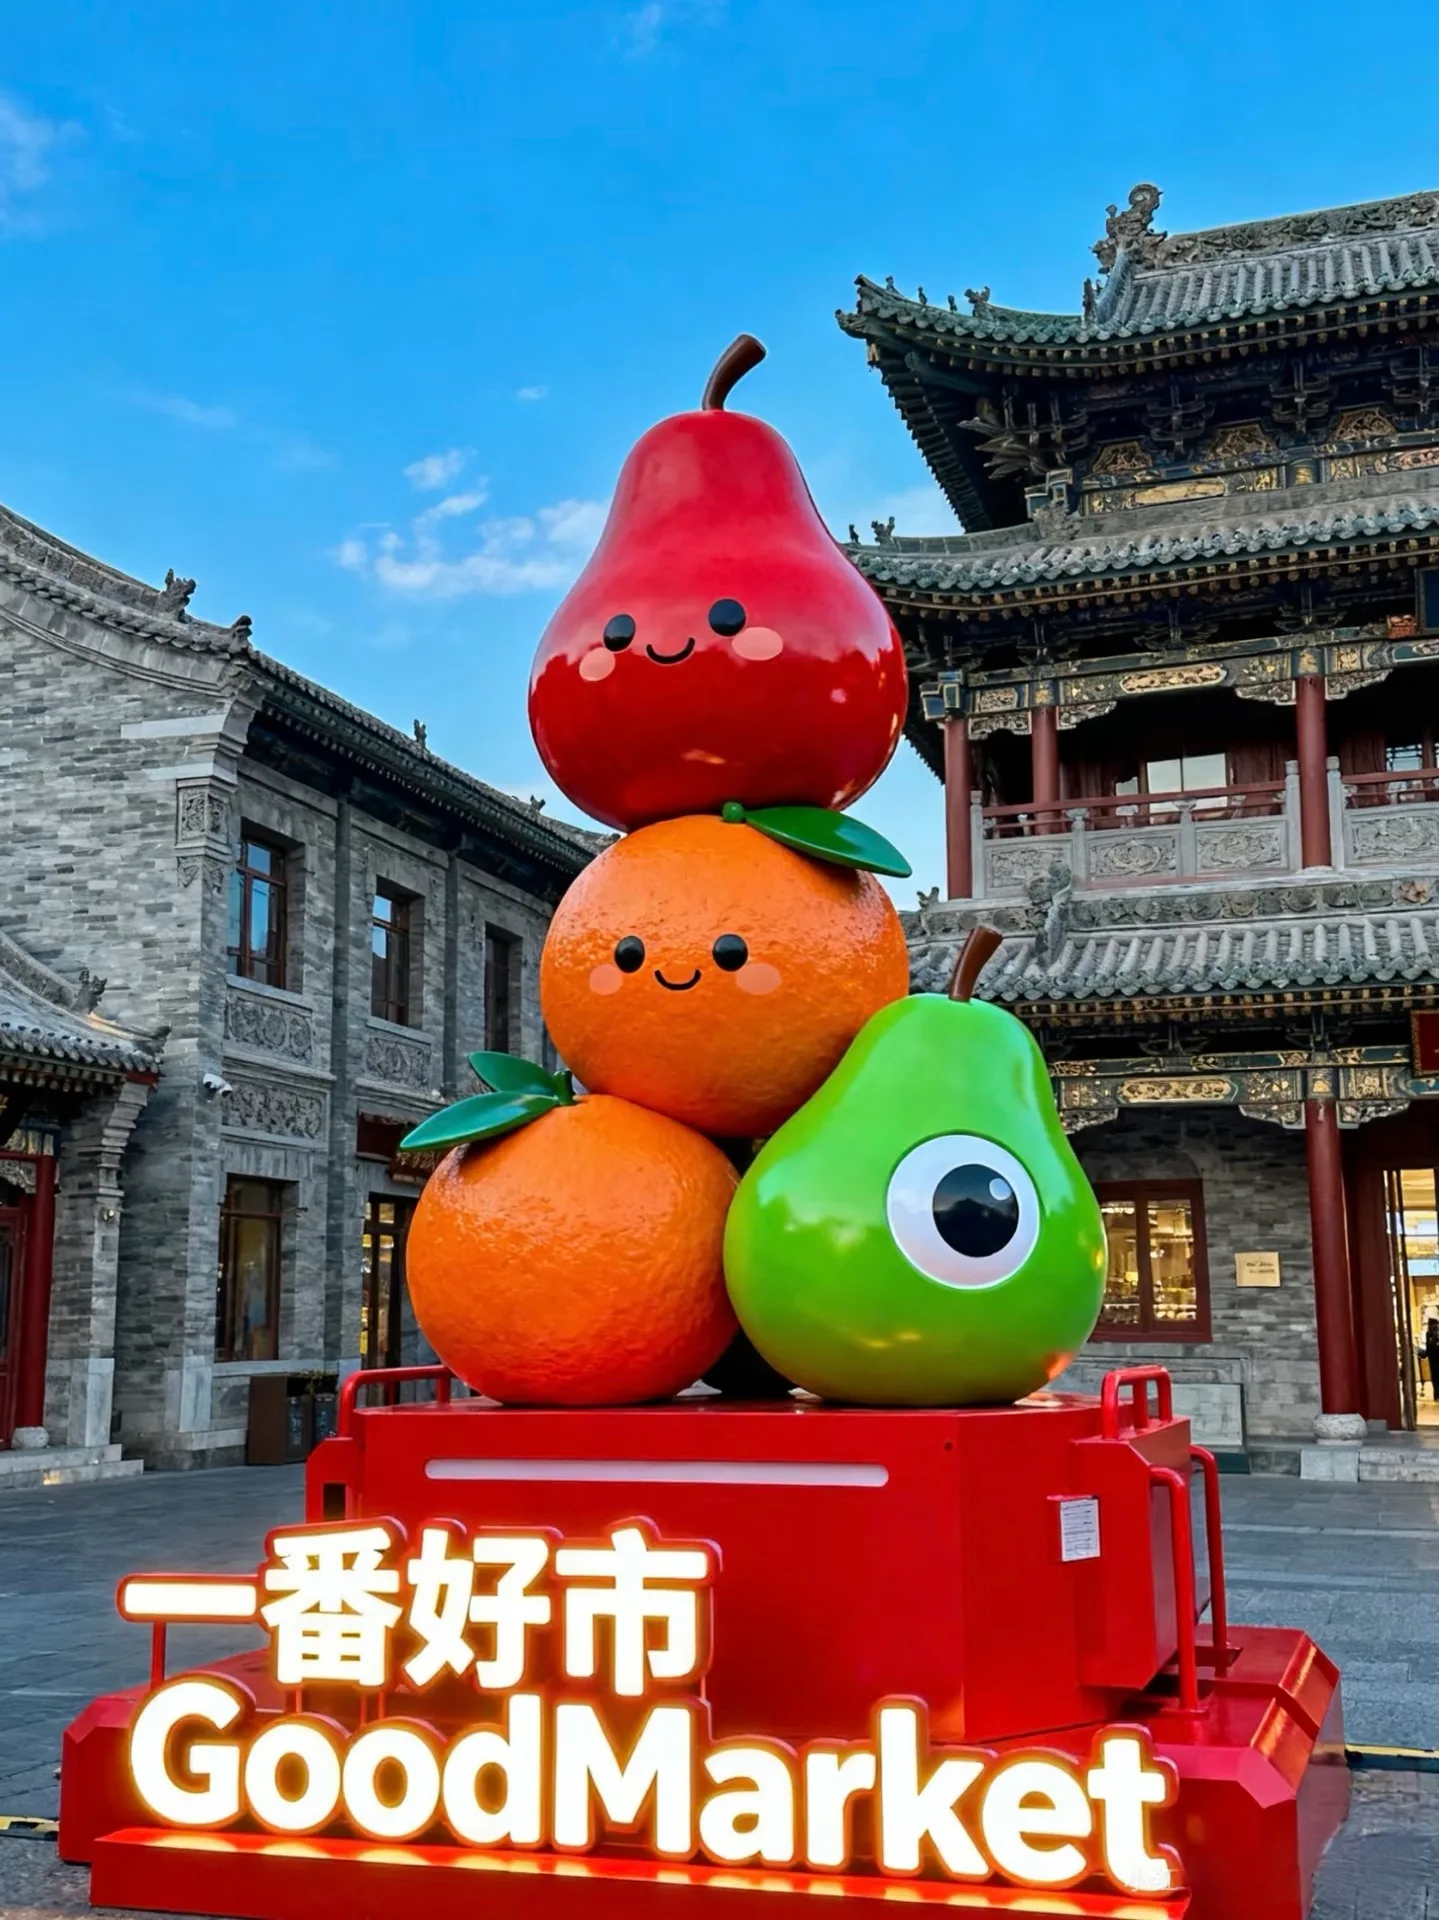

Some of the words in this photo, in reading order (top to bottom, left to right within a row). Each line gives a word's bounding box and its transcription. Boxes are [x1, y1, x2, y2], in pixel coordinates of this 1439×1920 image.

[123, 1526, 708, 1696] 一番好市
[130, 1680, 1172, 1892] GoodMarket
